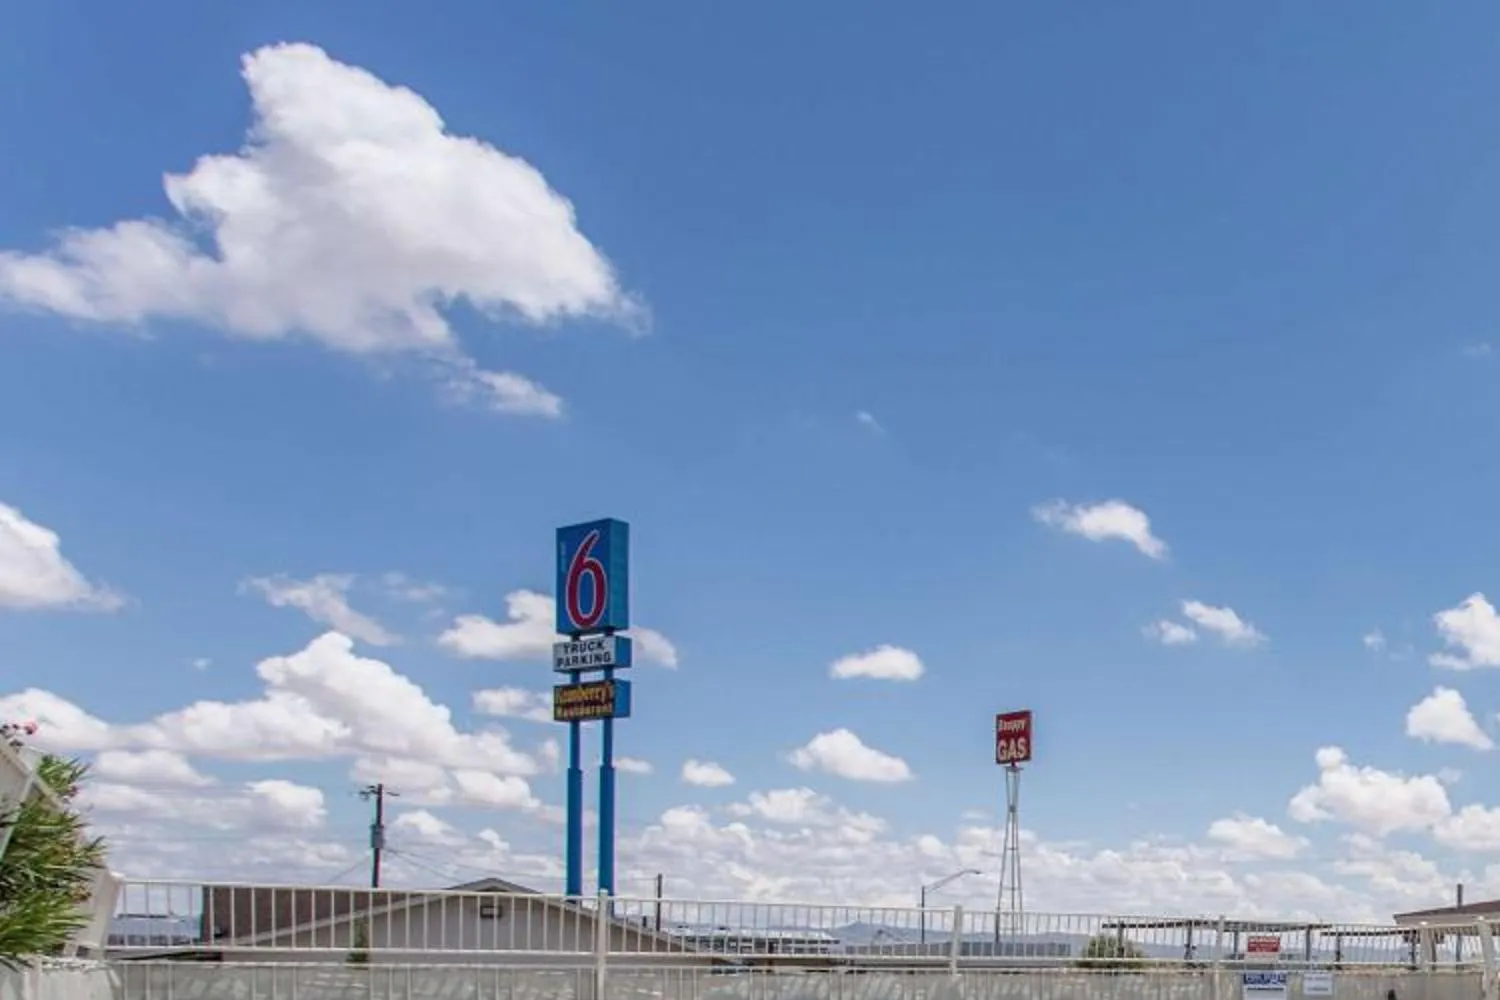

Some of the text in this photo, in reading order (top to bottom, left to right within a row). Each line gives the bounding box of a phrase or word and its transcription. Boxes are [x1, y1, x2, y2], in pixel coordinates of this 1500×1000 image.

[566, 529, 607, 630] 6
[563, 640, 605, 654] TRUCK
[556, 651, 611, 667] PARKING
[998, 737, 1026, 760] GAS
